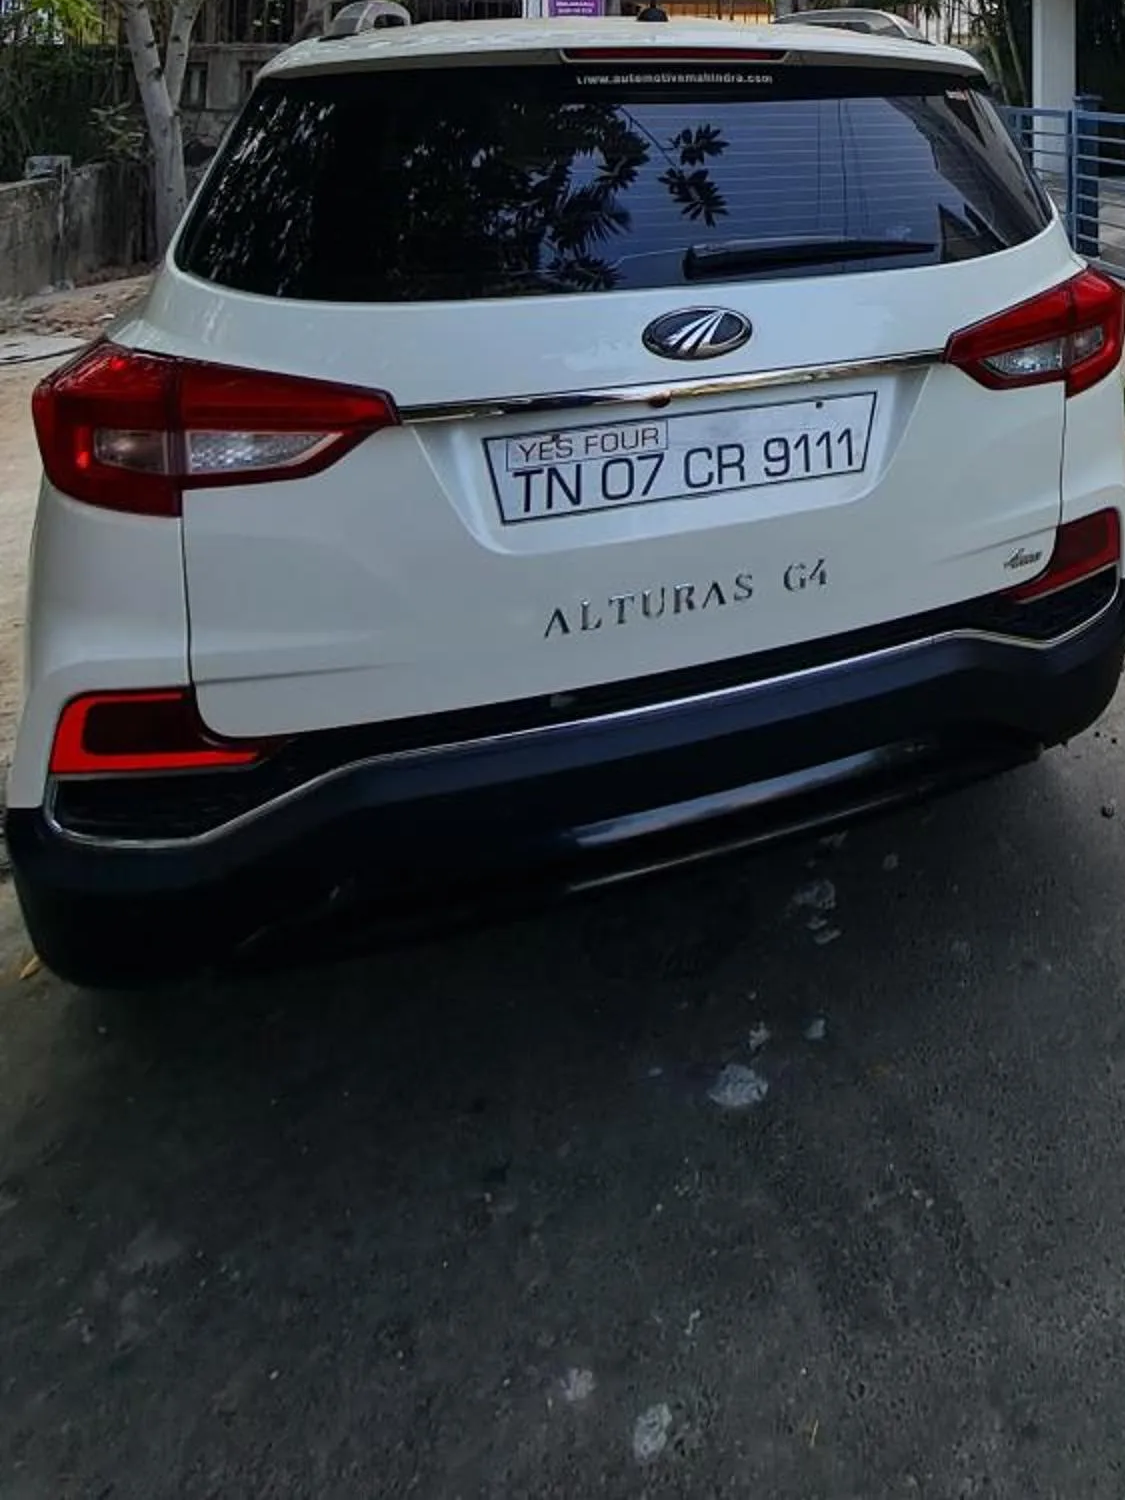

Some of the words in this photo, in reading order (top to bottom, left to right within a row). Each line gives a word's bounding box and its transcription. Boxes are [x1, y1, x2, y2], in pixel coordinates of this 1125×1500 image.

[512, 463, 582, 514] TN
[601, 454, 666, 501] 07
[683, 443, 745, 490] CR
[763, 427, 854, 479] 9111
[518, 434, 574, 463] YES
[584, 426, 660, 455] FOUR
[543, 572, 754, 639] ALTURAS
[783, 557, 828, 593] G4
